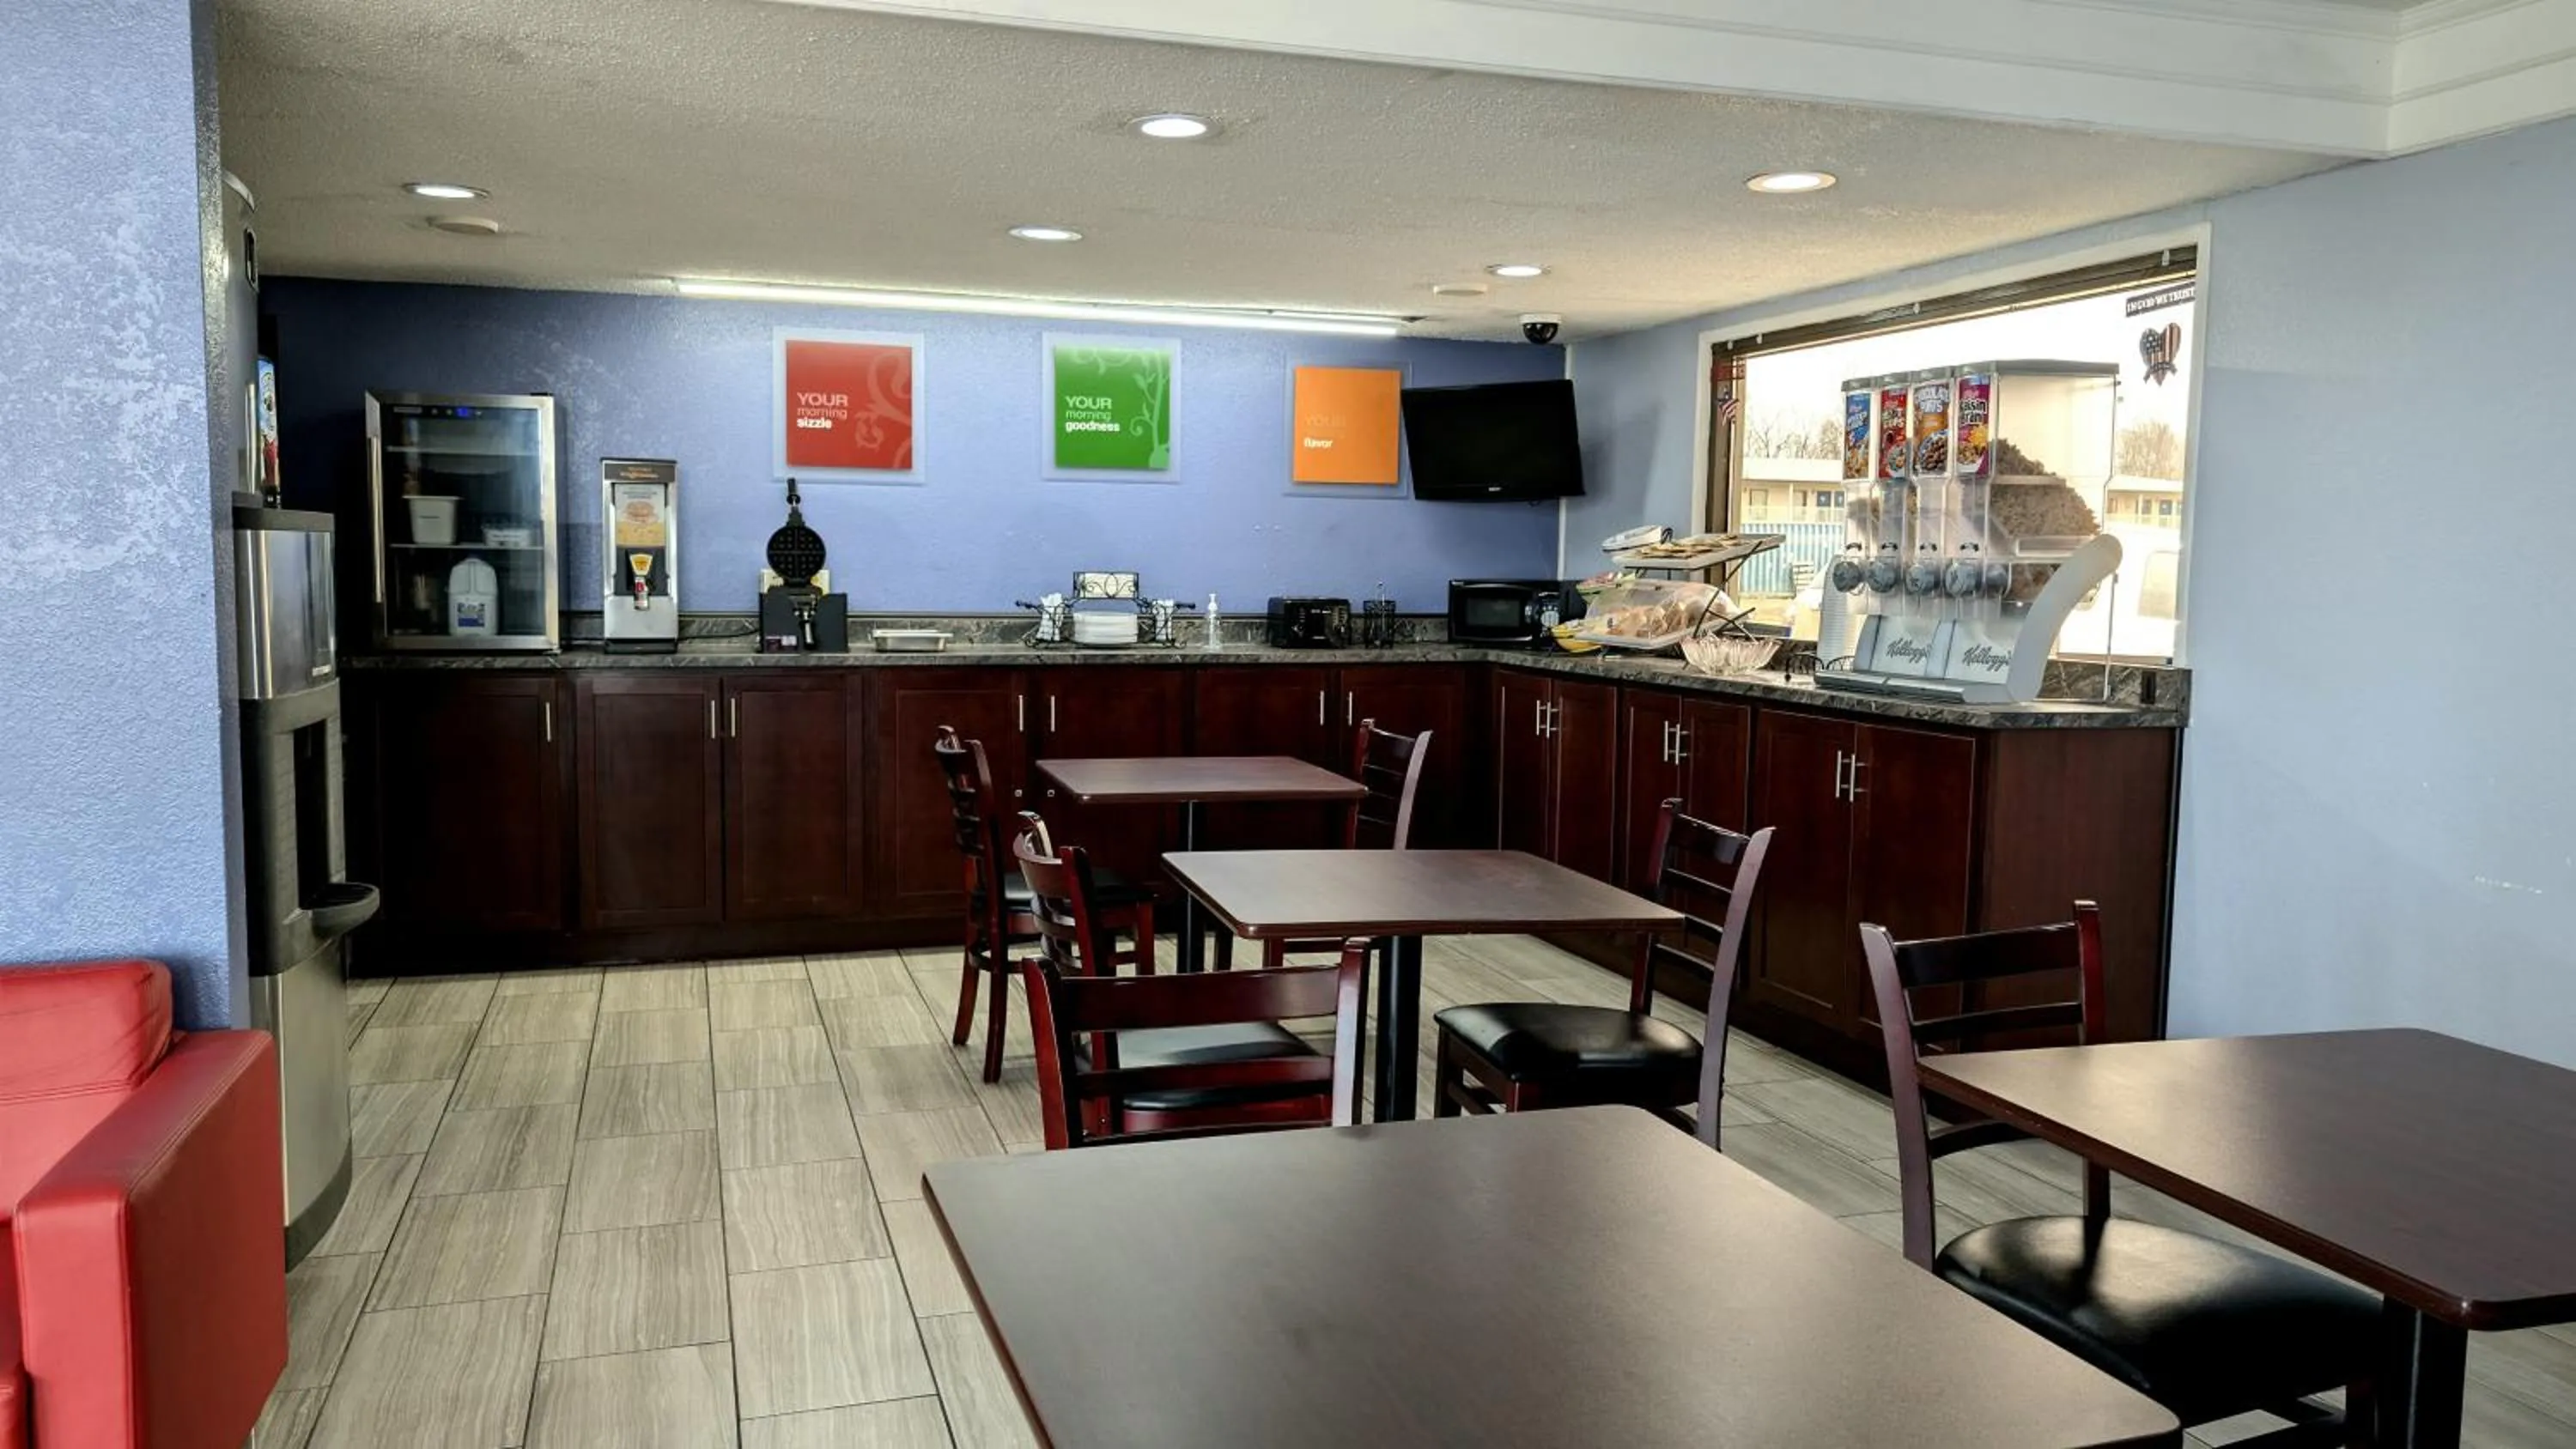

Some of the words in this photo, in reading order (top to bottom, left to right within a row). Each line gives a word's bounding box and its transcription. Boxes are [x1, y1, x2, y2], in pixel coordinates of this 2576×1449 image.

[797, 392, 848, 406] YOUR
[1066, 396, 1112, 409] YOUR
[797, 406, 848, 421] morning
[1066, 410, 1112, 422] morning
[797, 416, 832, 428] sizzle
[1066, 421, 1121, 433] goodness
[1304, 437, 1333, 449] flavor
